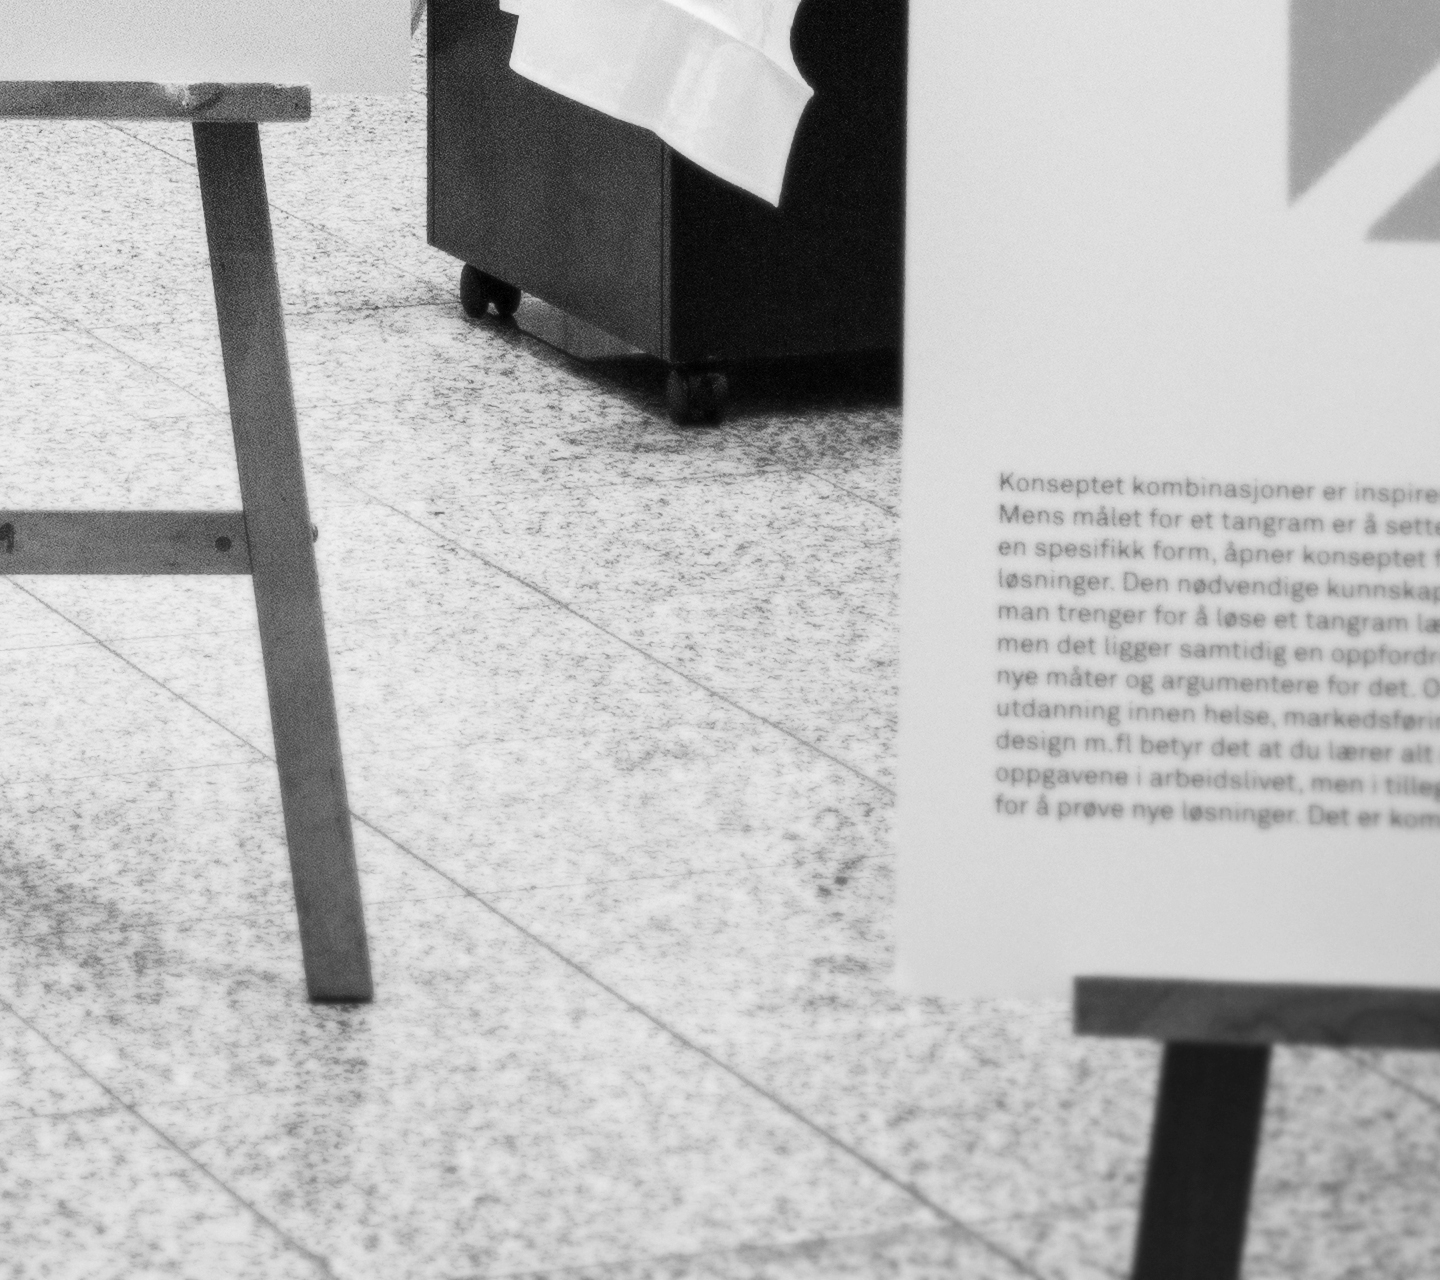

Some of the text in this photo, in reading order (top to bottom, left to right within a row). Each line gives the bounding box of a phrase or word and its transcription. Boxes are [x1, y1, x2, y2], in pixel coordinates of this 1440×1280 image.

[997, 466, 1125, 501] Konseptet
[1130, 470, 1315, 507] kombinasjoner
[1321, 483, 1346, 501] er
[997, 498, 1065, 525] Mens
[1072, 498, 1142, 527] målet
[1148, 503, 1182, 528] for
[1189, 504, 1215, 529] et
[1220, 505, 1326, 539] tangram
[1330, 515, 1356, 534] er
[1363, 507, 1379, 534] å
[997, 538, 1027, 557] en
[1034, 532, 1145, 567] spesifikk
[1223, 536, 1294, 571] åpner
[1300, 541, 1428, 575] konseptet
